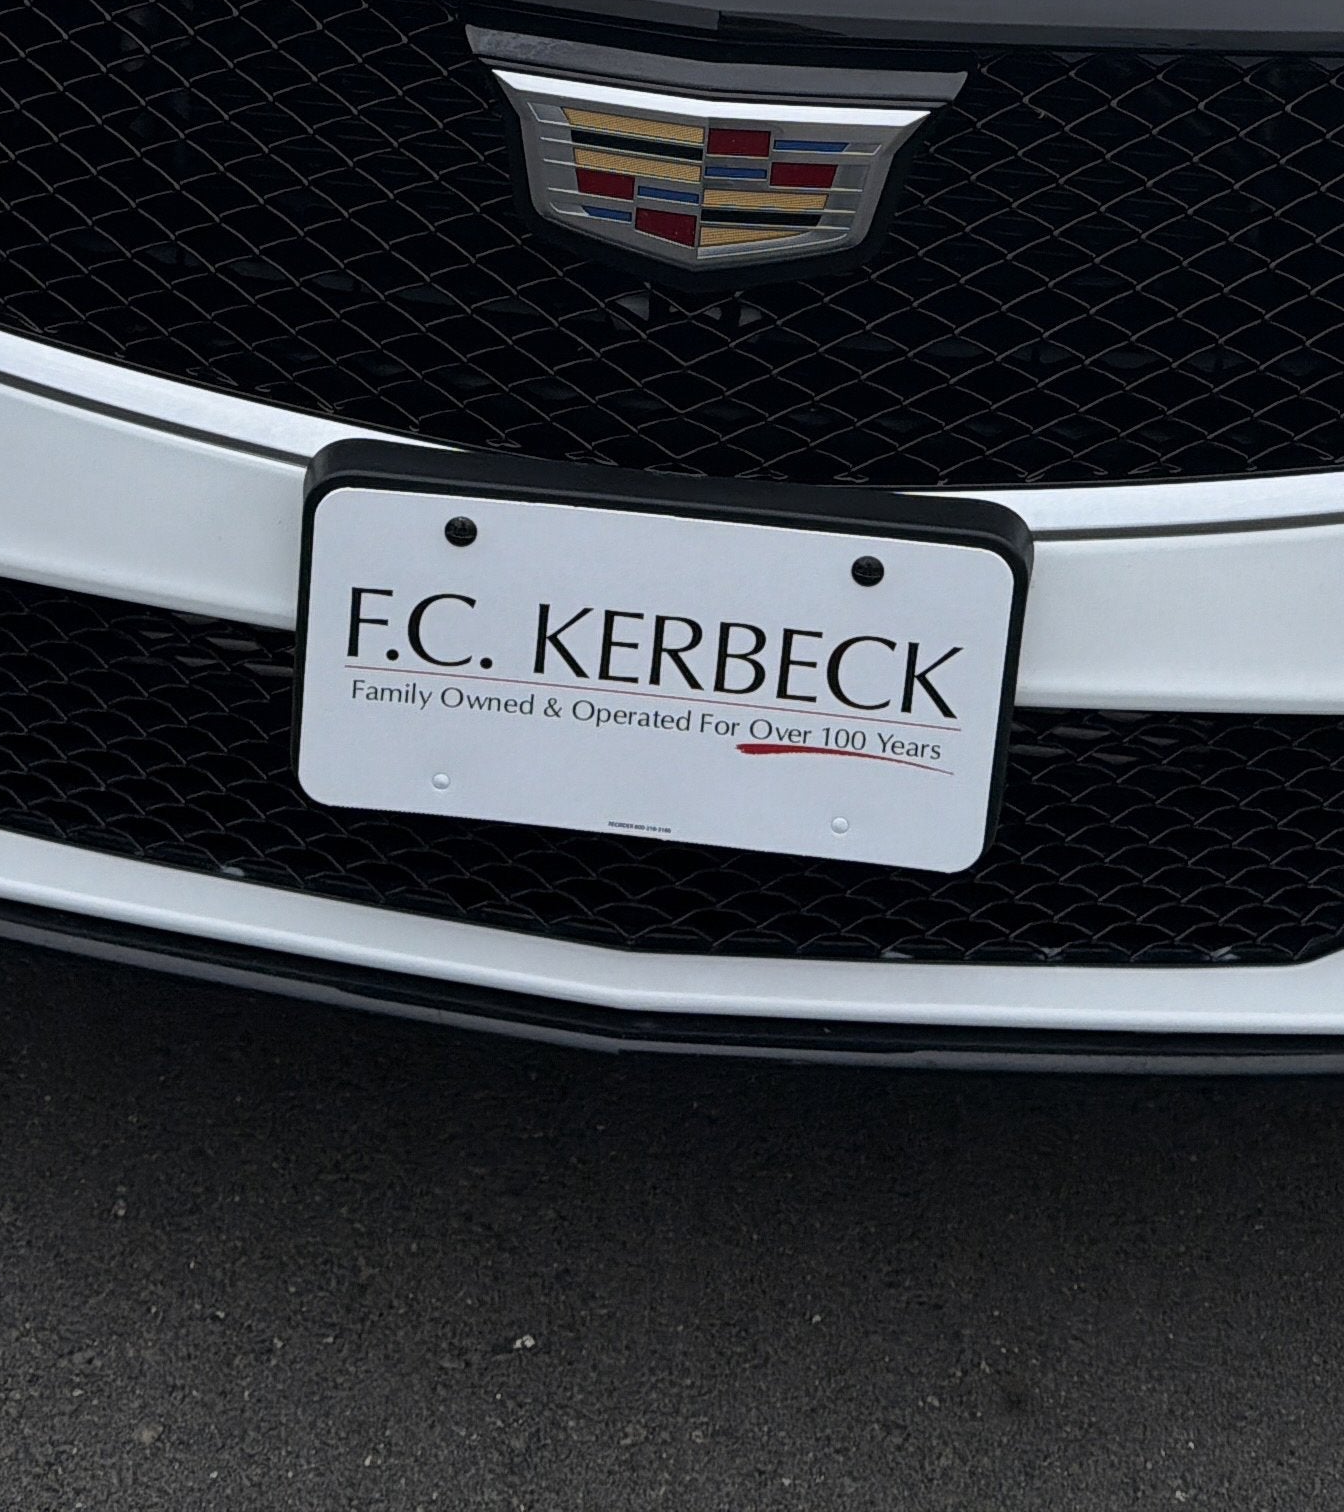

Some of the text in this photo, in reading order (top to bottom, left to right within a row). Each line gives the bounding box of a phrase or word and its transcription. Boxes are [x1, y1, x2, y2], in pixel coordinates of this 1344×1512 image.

[347, 586, 964, 719] F.C. KERBECK
[351, 679, 942, 760] Family Owned & Operated For Over 100 Years
